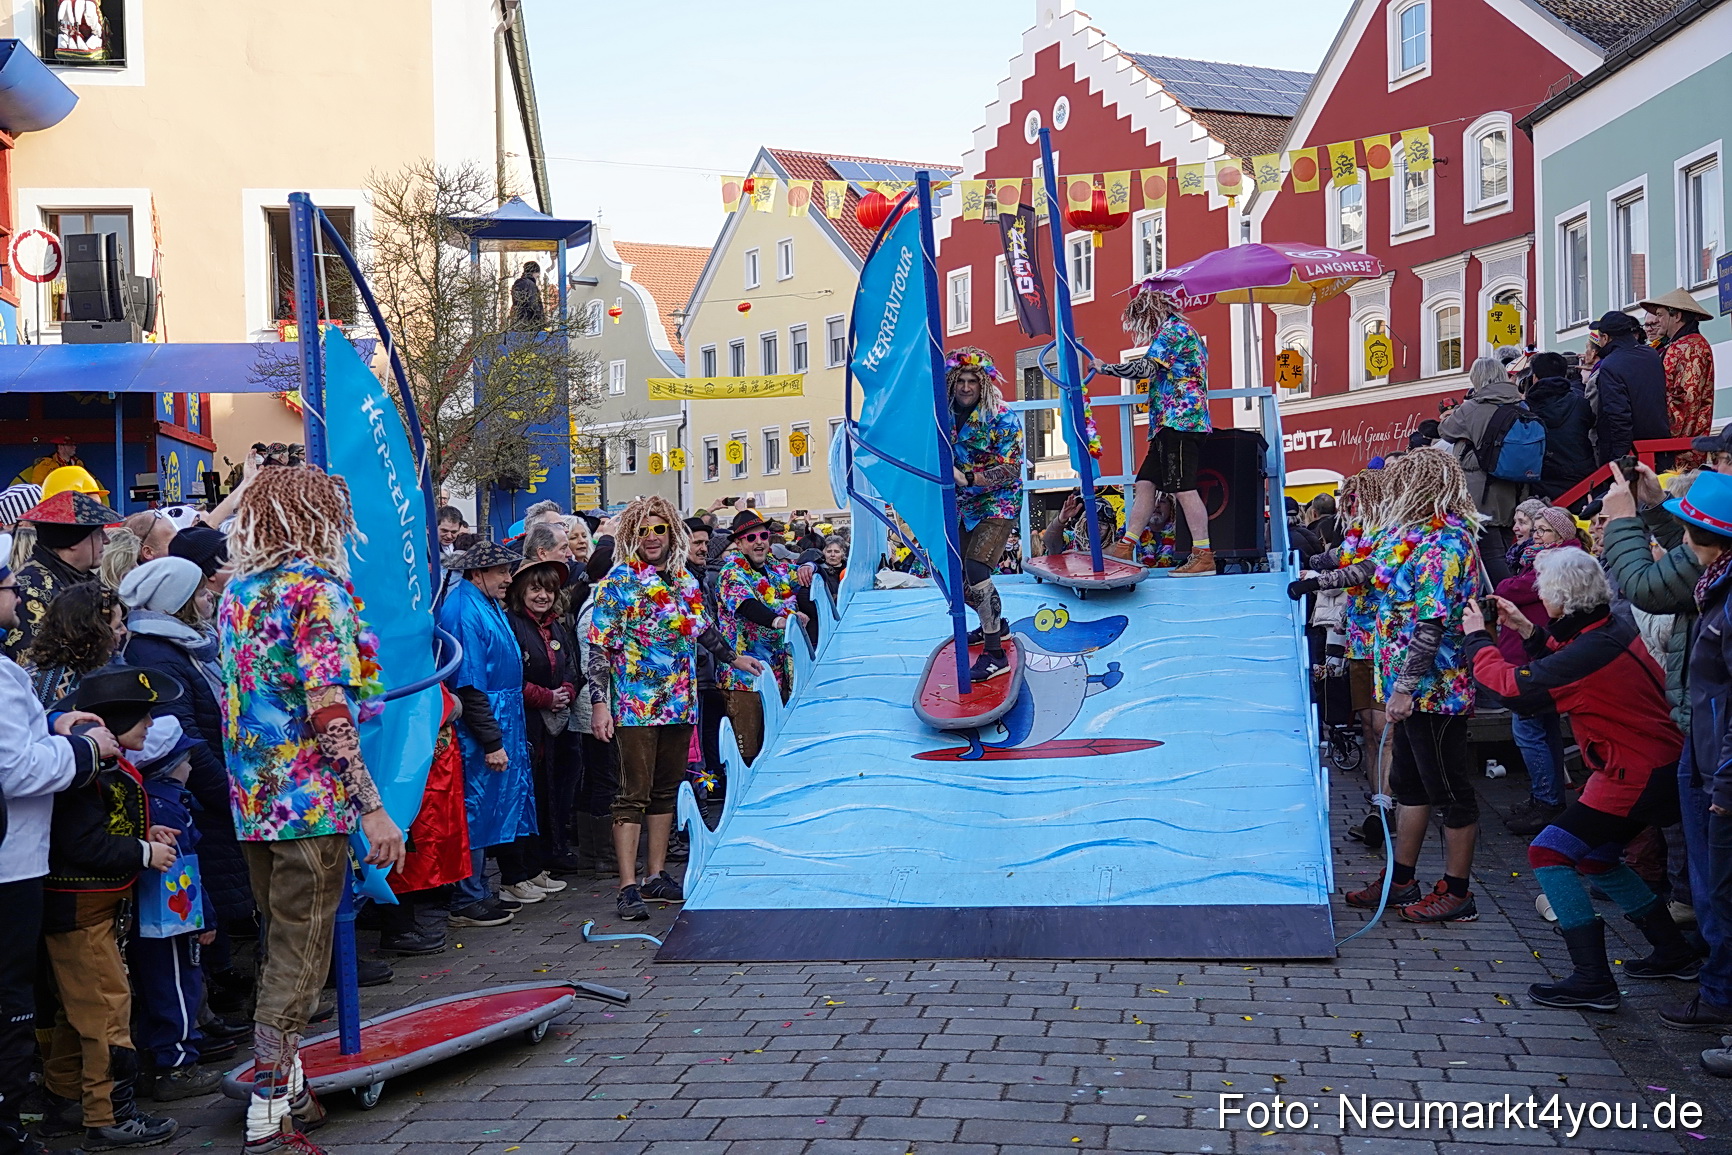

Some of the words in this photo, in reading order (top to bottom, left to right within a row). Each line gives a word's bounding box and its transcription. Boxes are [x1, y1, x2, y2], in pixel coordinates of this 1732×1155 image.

[862, 245, 913, 373] HERRENTOUR
[1339, 420, 1363, 448] Mode
[361, 393, 421, 611] HERRENTOUR
